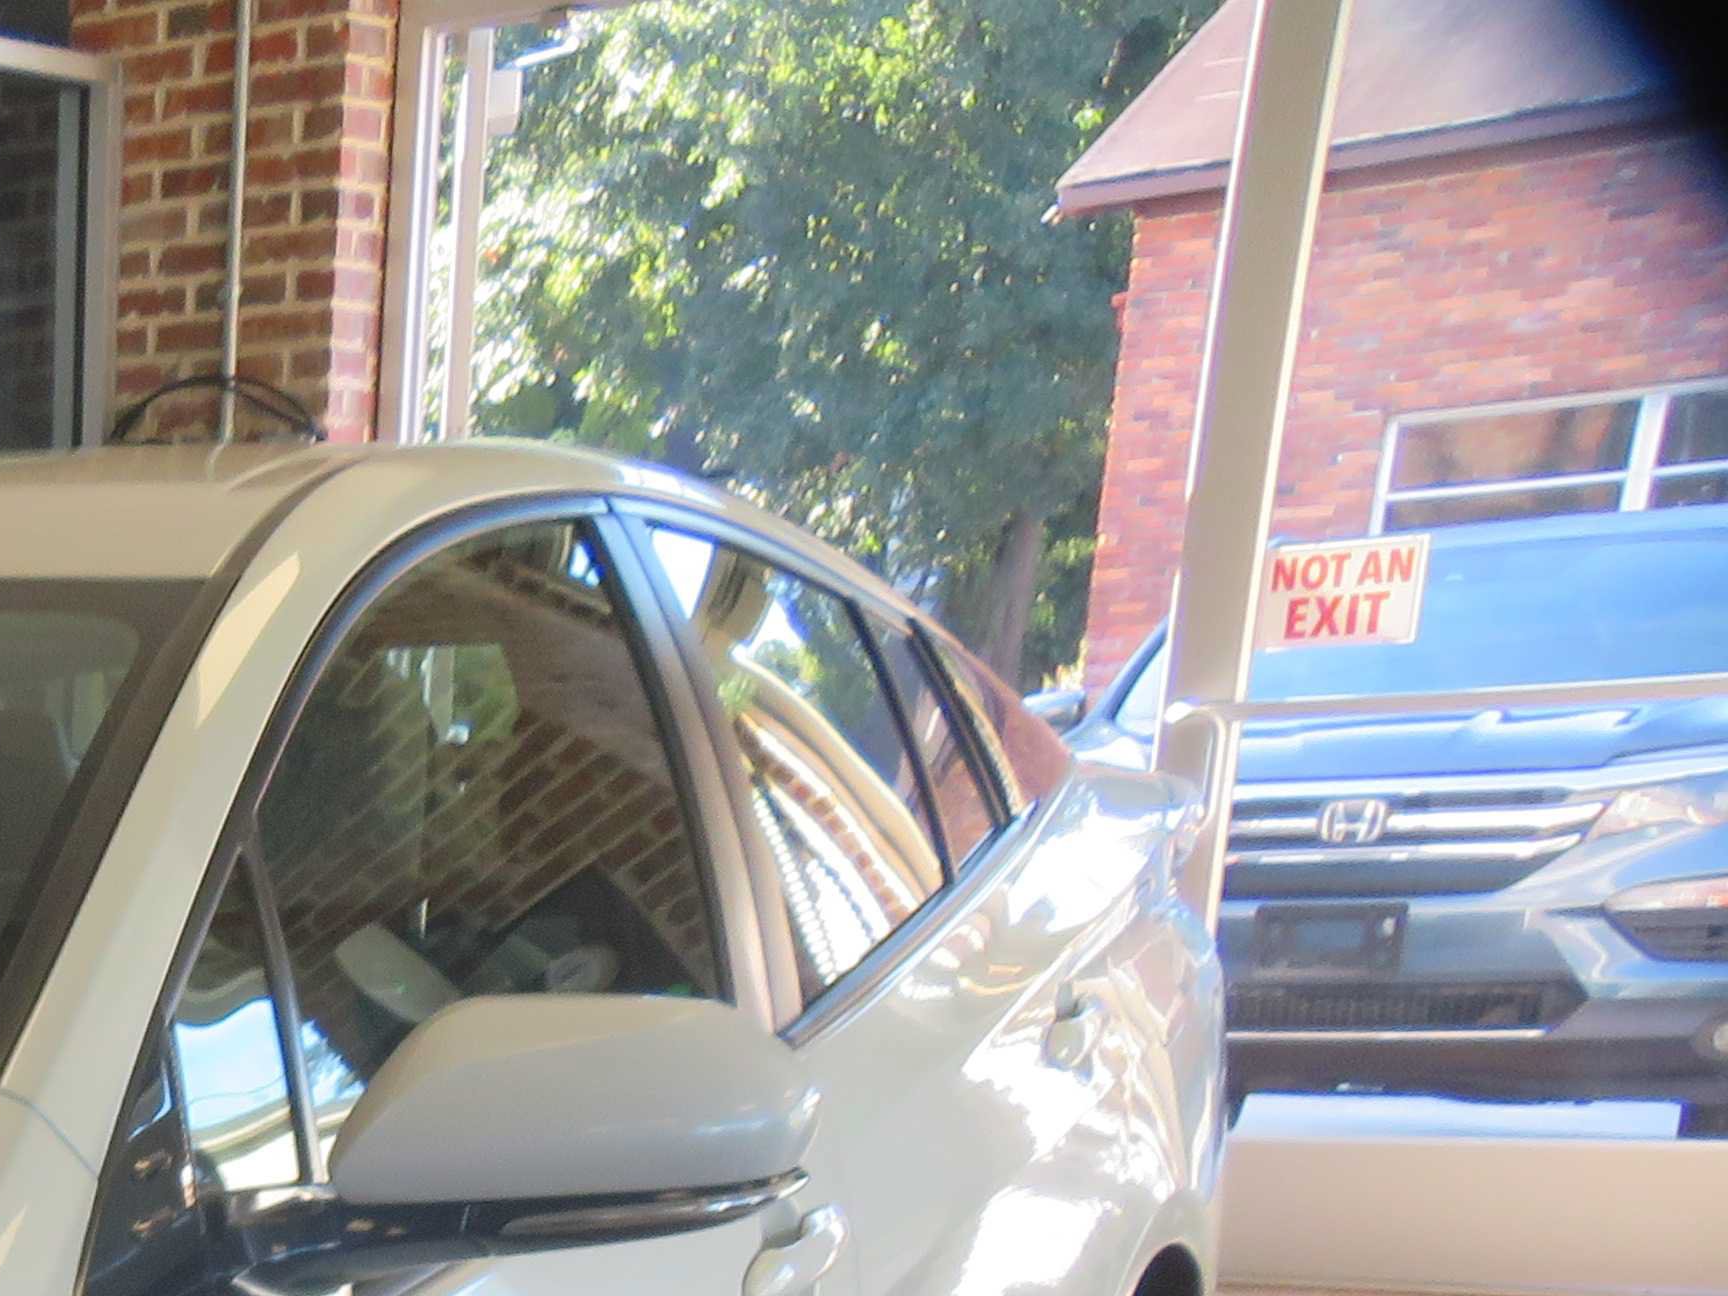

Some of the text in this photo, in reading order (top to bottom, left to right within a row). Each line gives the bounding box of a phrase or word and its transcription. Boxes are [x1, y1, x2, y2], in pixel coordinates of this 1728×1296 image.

[1271, 548, 1415, 591] NOT AN
[1285, 592, 1390, 639] EXIT
